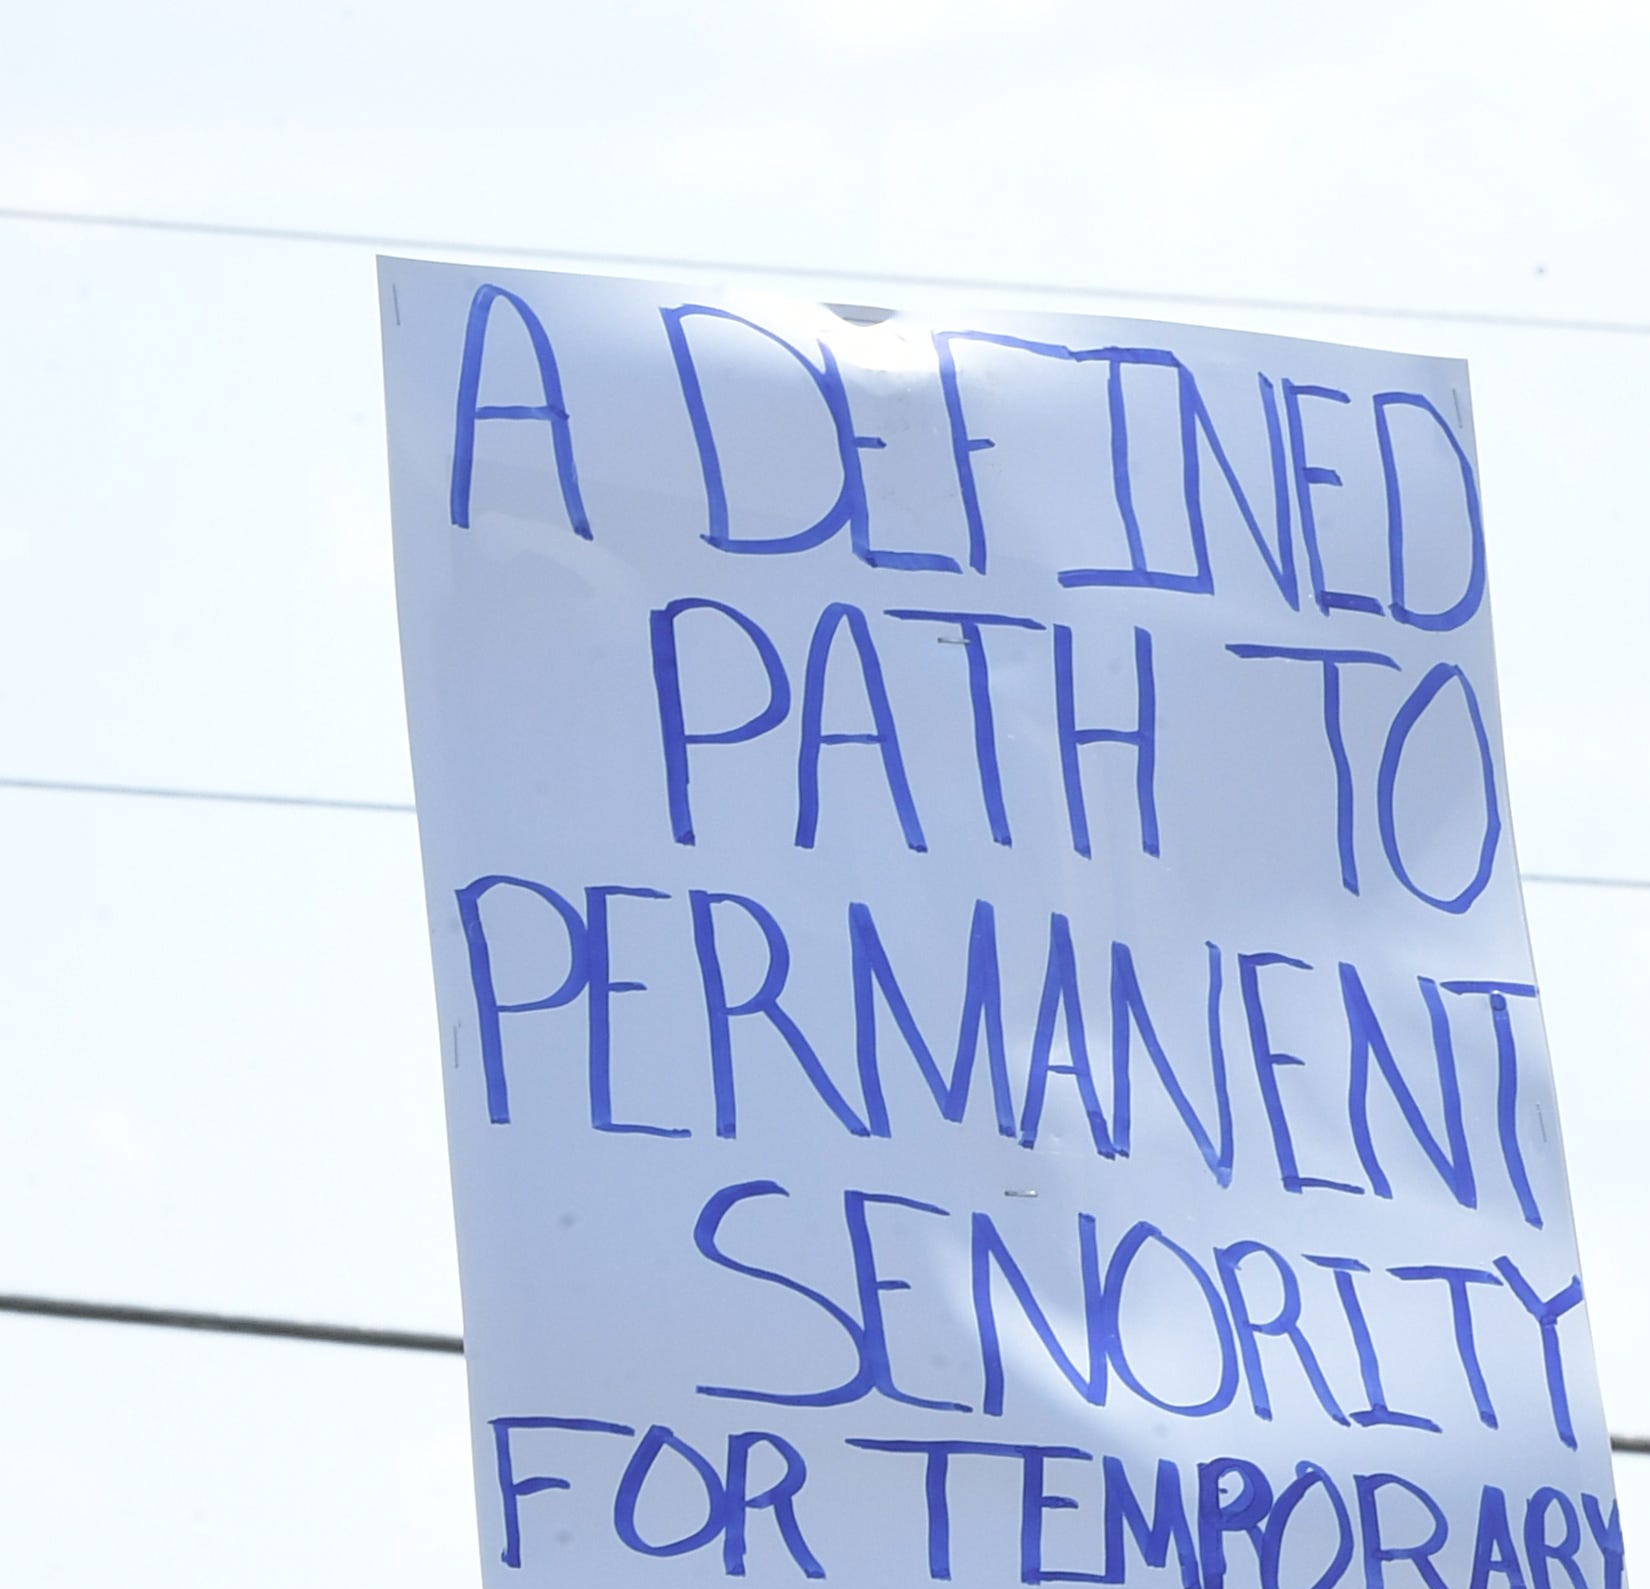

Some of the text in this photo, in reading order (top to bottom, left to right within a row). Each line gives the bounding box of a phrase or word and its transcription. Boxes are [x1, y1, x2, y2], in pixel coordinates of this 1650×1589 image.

[450, 283, 1489, 633] A DEFINED
[650, 597, 1502, 914] PATH TO
[454, 873, 1540, 1230] PERMANENT
[694, 1180, 1586, 1451] SENORITY
[489, 1417, 827, 1580] FOR
